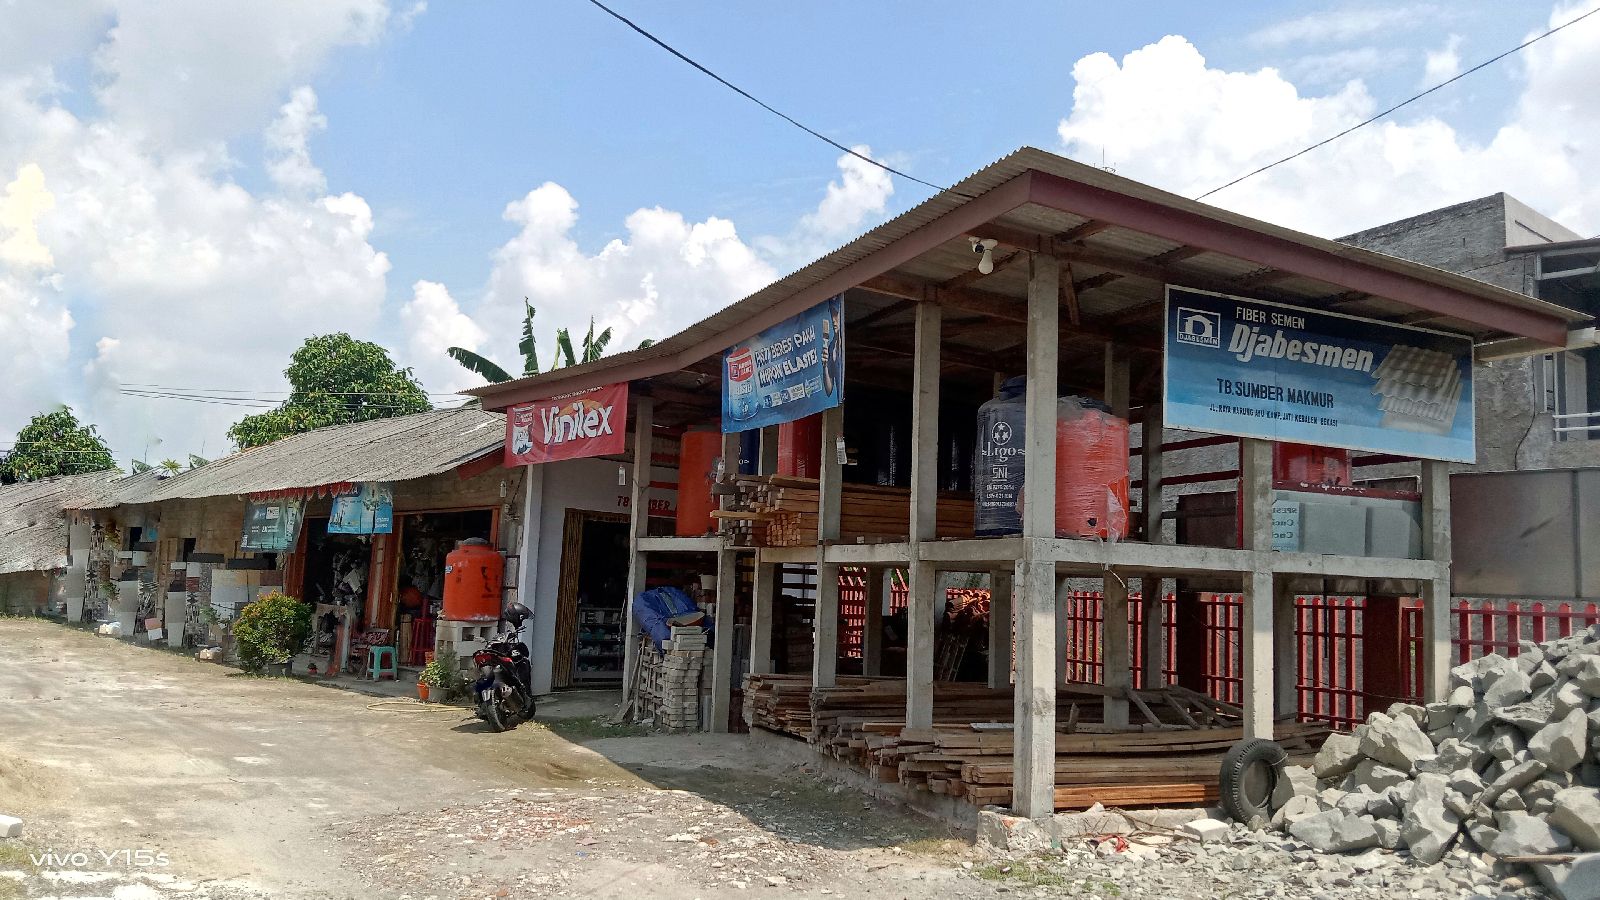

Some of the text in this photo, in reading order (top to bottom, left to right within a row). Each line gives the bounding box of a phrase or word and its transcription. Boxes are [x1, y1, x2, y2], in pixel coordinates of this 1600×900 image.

[1236, 306, 1305, 330] FIBER SEMEN
[1228, 323, 1374, 373] Djabesmen
[1287, 389, 1334, 409] MAKMUR
[541, 401, 613, 445] Vinilex
